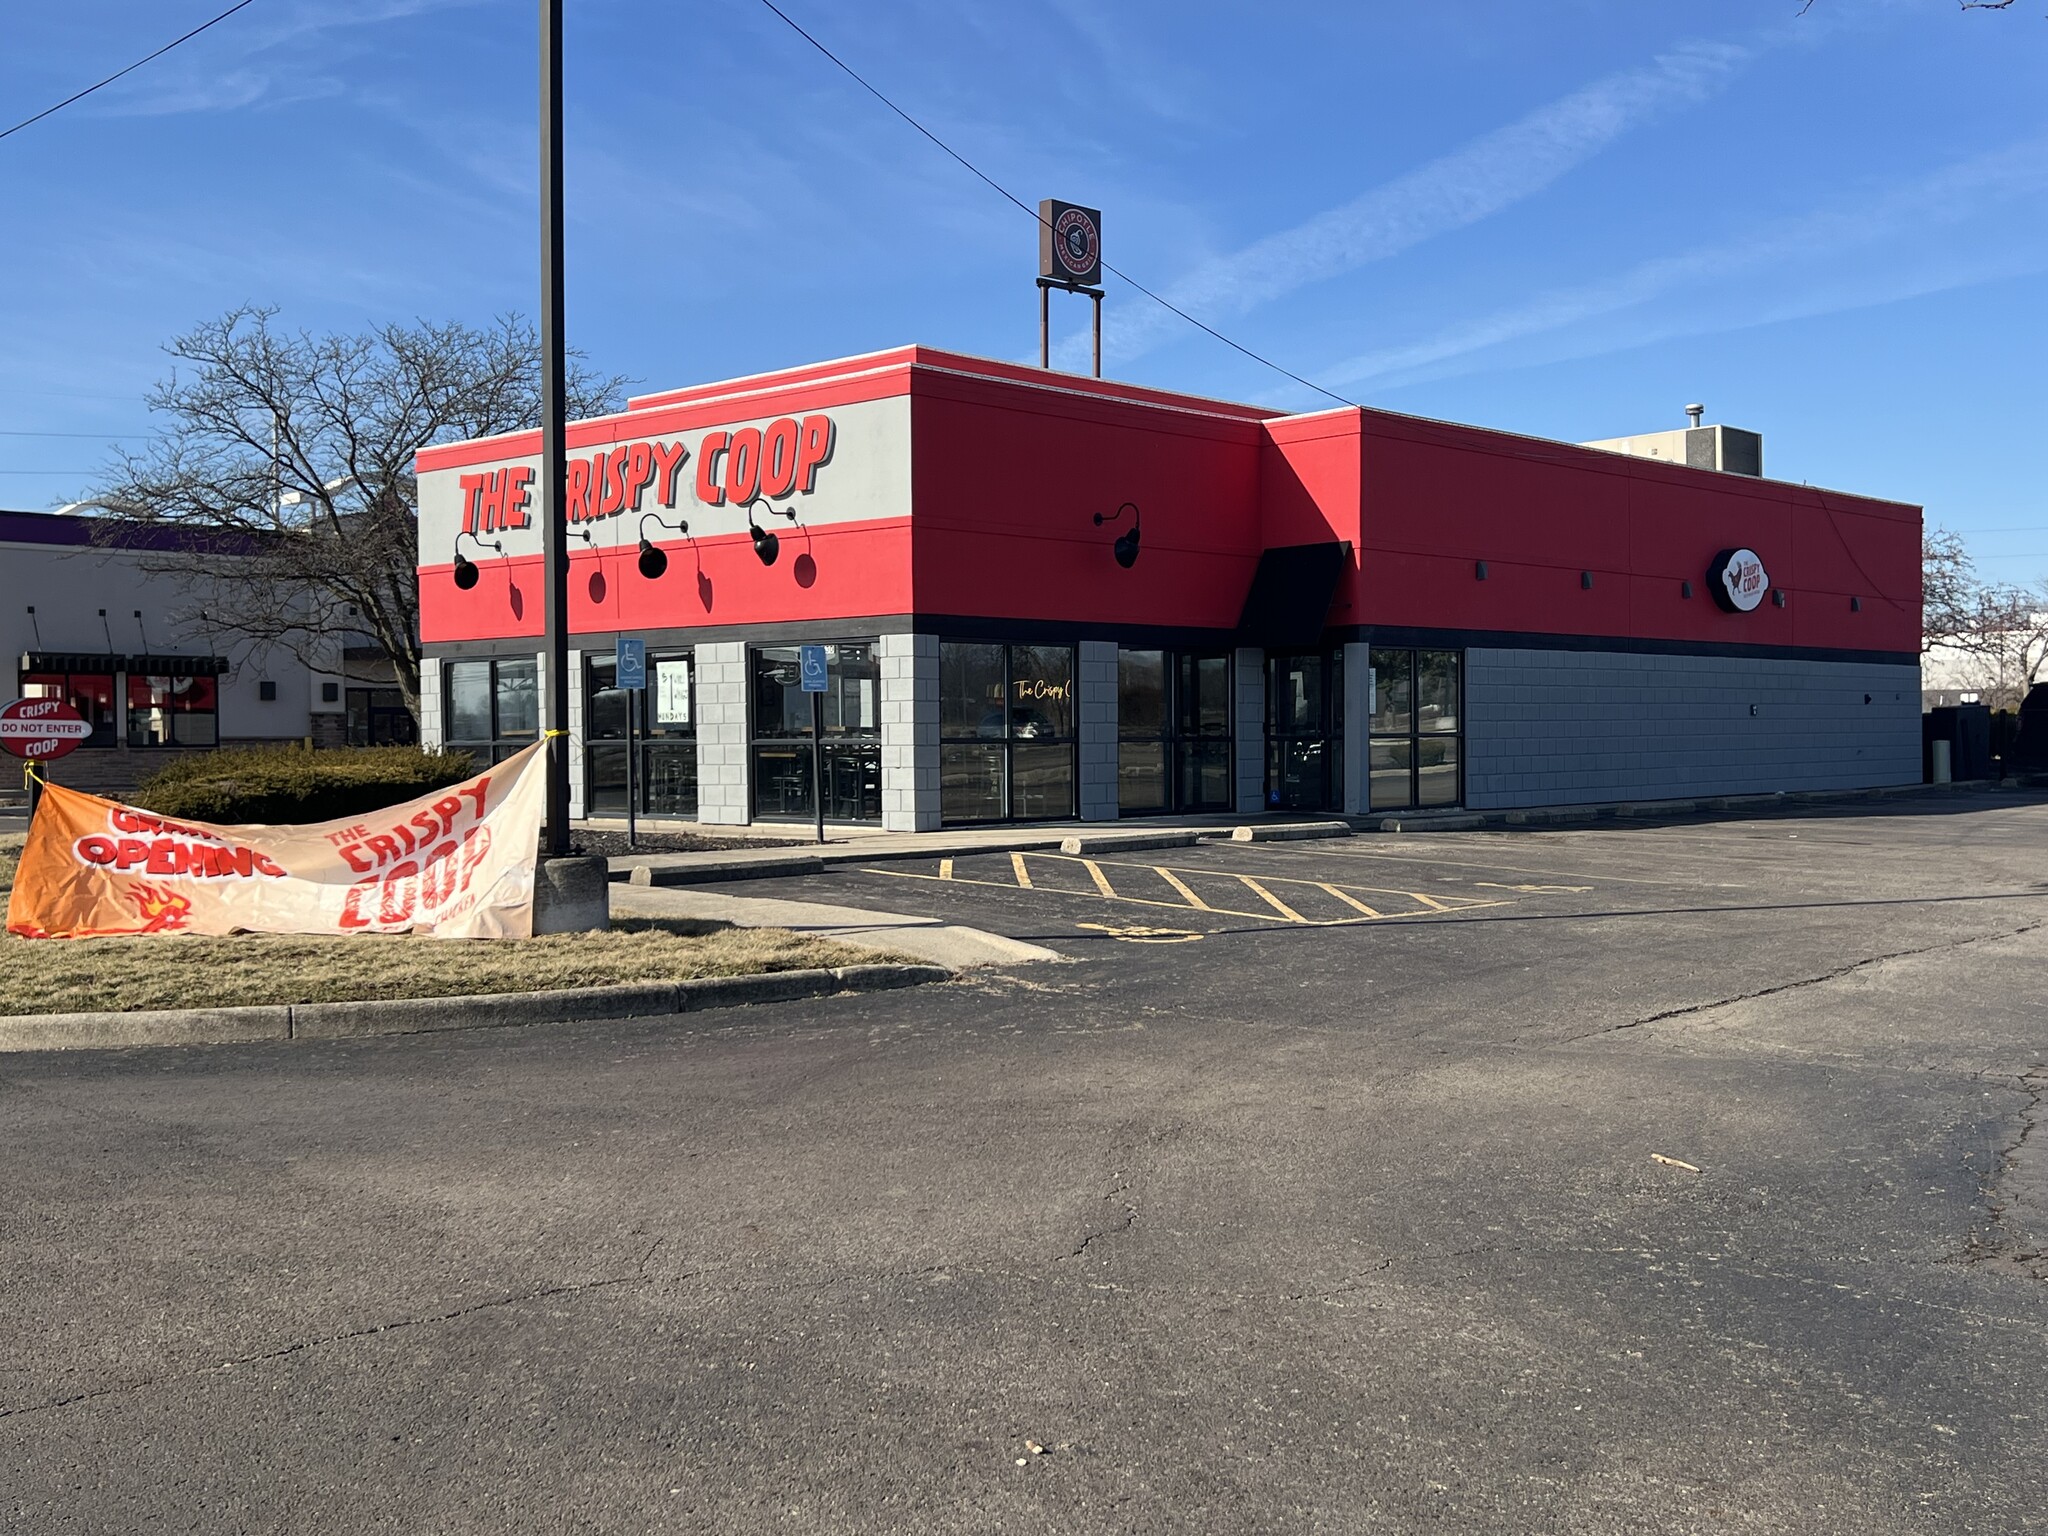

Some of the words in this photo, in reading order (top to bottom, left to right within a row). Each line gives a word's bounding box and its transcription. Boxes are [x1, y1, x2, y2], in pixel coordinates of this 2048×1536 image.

[1059, 213, 1095, 239] CHIPOTLE
[459, 466, 533, 533] THE
[566, 440, 689, 523] RISPY
[696, 414, 834, 506] COOP
[1743, 575, 1760, 592] COOP
[1013, 680, 1034, 699] The
[1034, 680, 1063, 699] Crispy
[20, 701, 60, 718] CRISPY
[2, 723, 18, 733] DO
[21, 723, 43, 733] NOT
[46, 724, 82, 734] ENTER
[25, 738, 58, 756] COOP
[324, 824, 371, 846] THE
[339, 777, 492, 873] CRISPY
[77, 836, 287, 878] OPENING
[339, 824, 491, 928] COOP
